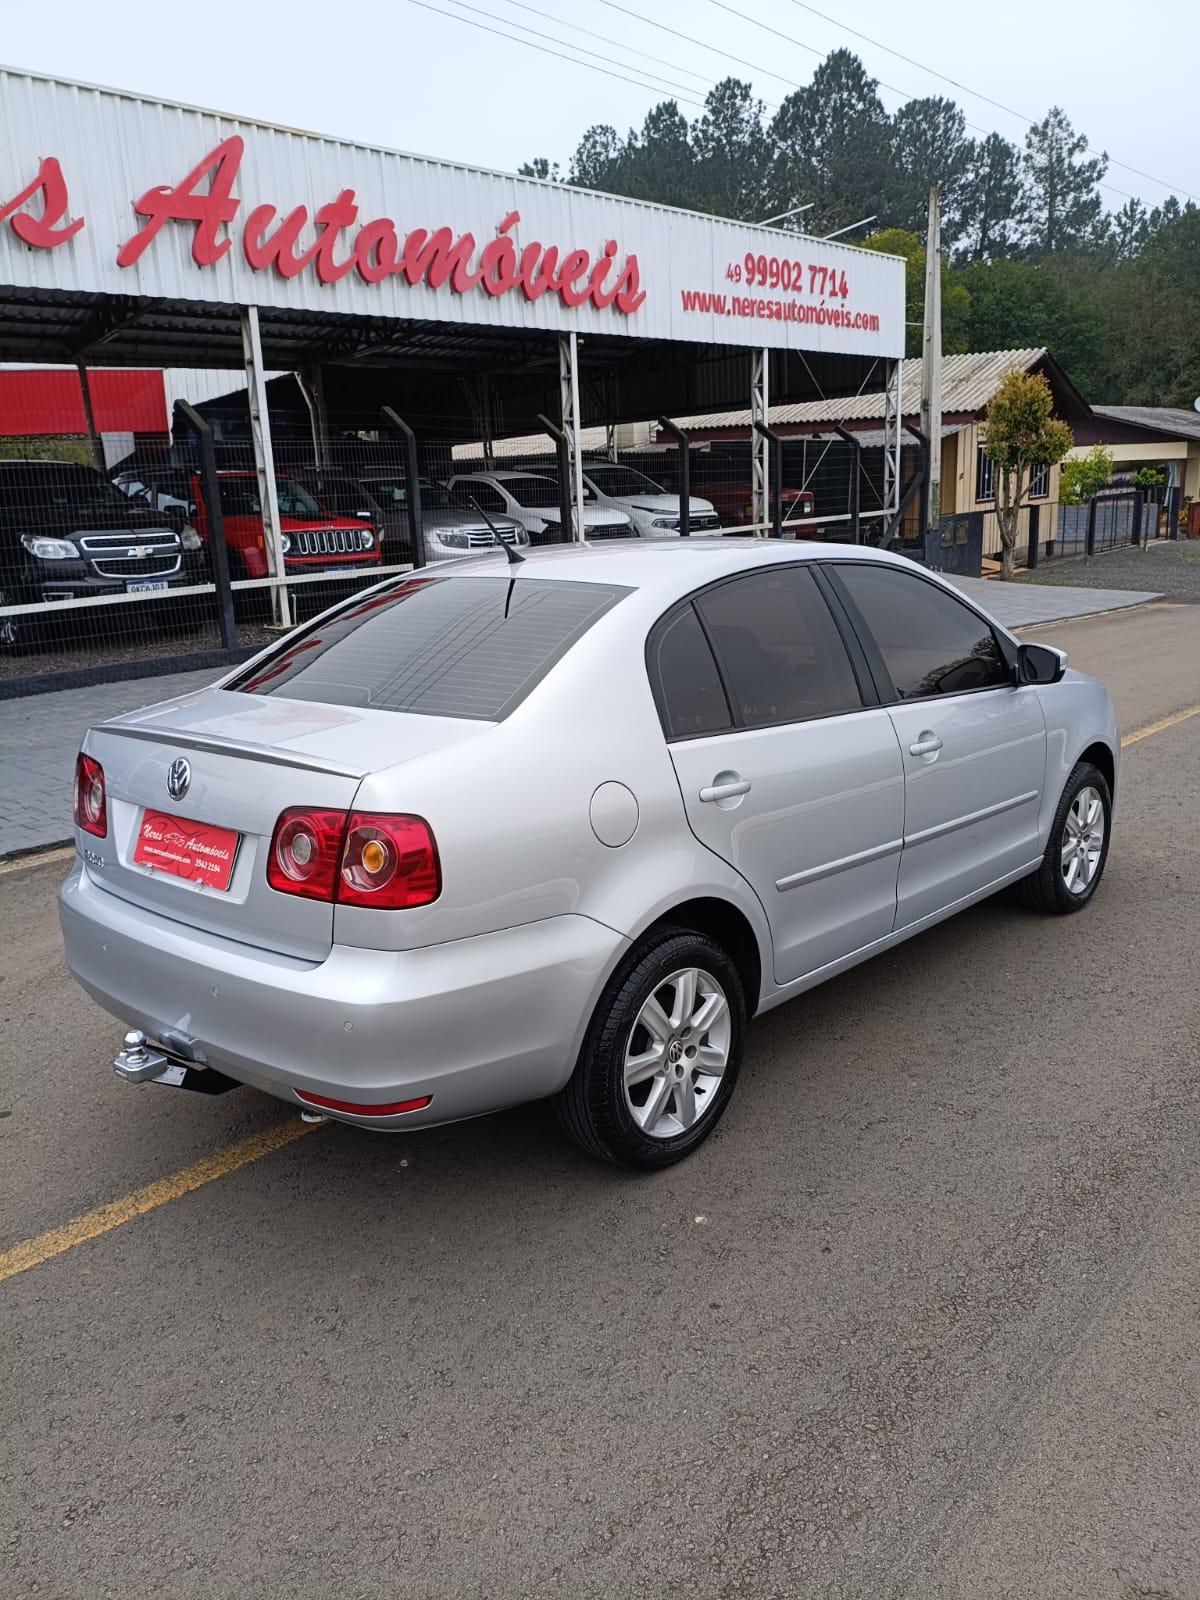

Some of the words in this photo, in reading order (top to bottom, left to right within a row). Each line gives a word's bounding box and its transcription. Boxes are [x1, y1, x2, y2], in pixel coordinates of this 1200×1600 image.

[116, 134, 646, 314] Automóveis
[726, 263, 742, 283] 49
[744, 252, 803, 293] 99902
[808, 264, 849, 299] 7714
[680, 289, 881, 332] www.neresautomóveis.com
[143, 823, 162, 841] Neres
[184, 837, 230, 860] Automóveis
